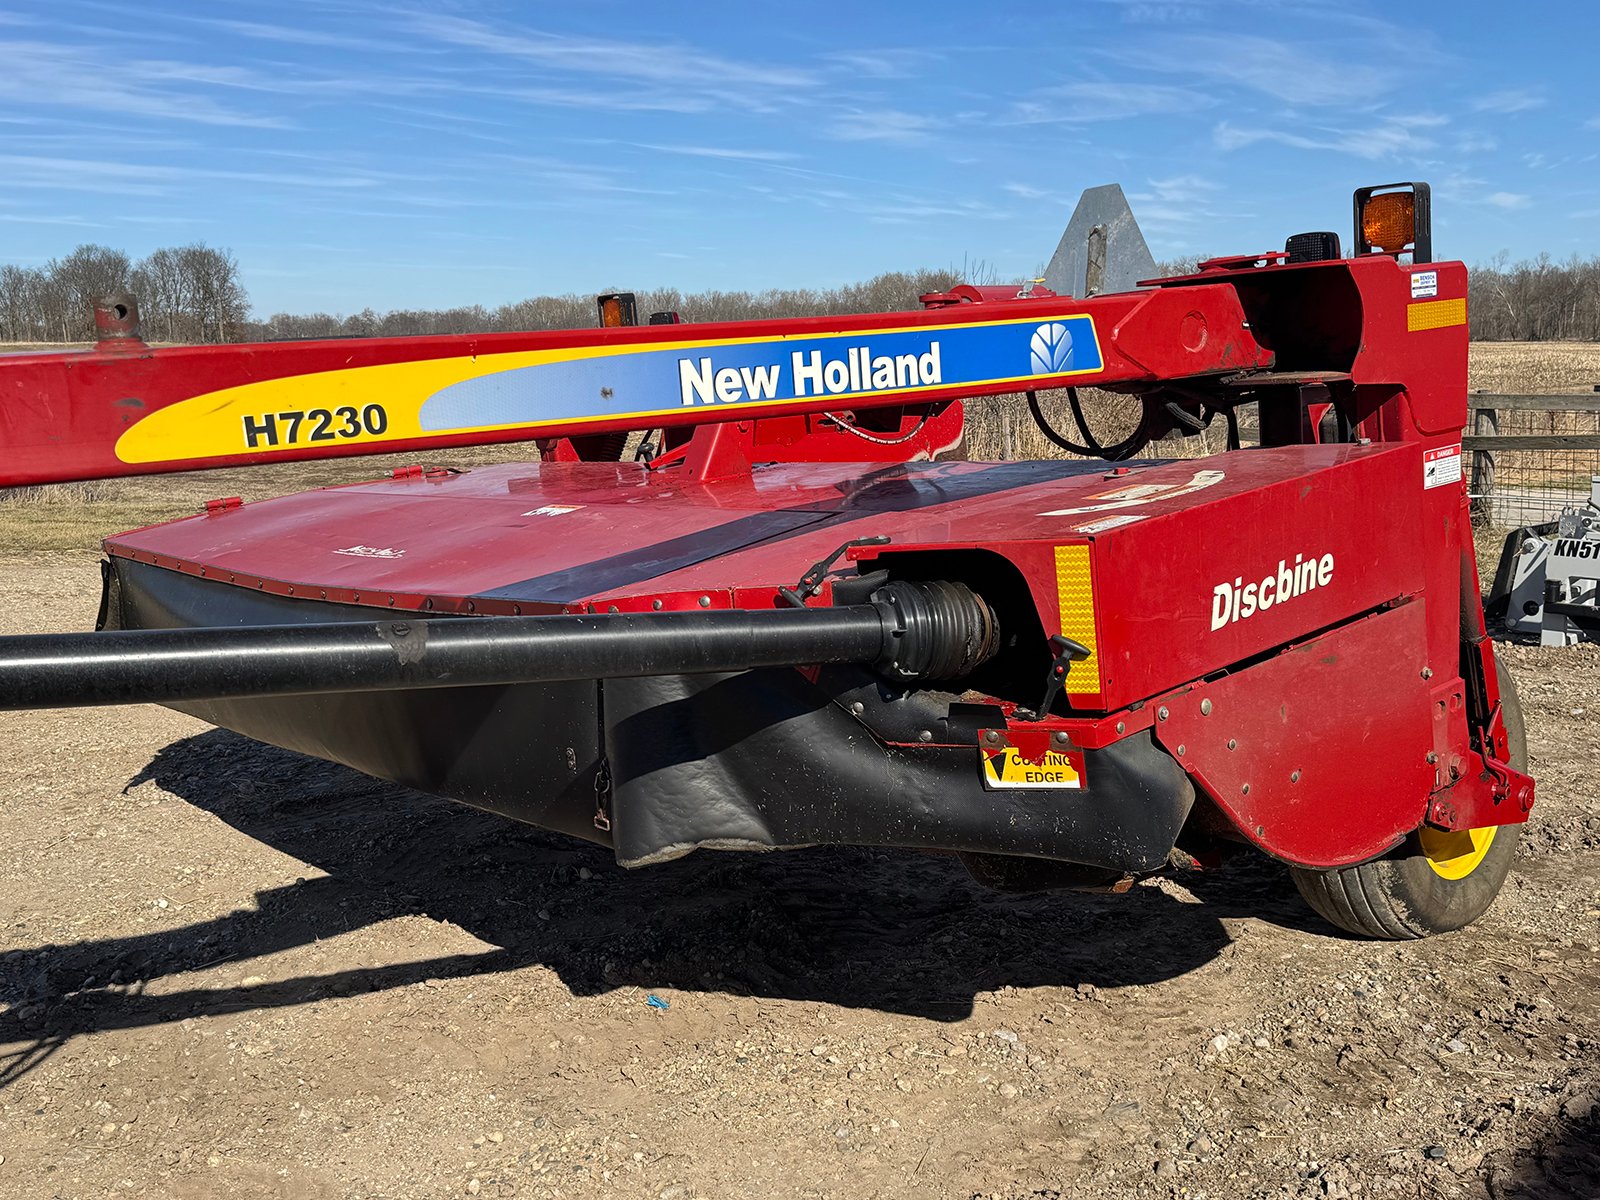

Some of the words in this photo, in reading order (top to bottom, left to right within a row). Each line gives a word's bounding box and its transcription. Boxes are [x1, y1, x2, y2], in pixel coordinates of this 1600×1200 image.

[678, 357, 780, 406] New
[792, 341, 941, 396] Holland
[243, 403, 388, 448] H7230
[1211, 553, 1334, 632] Discbine
[1025, 772, 1063, 783] EDGE
